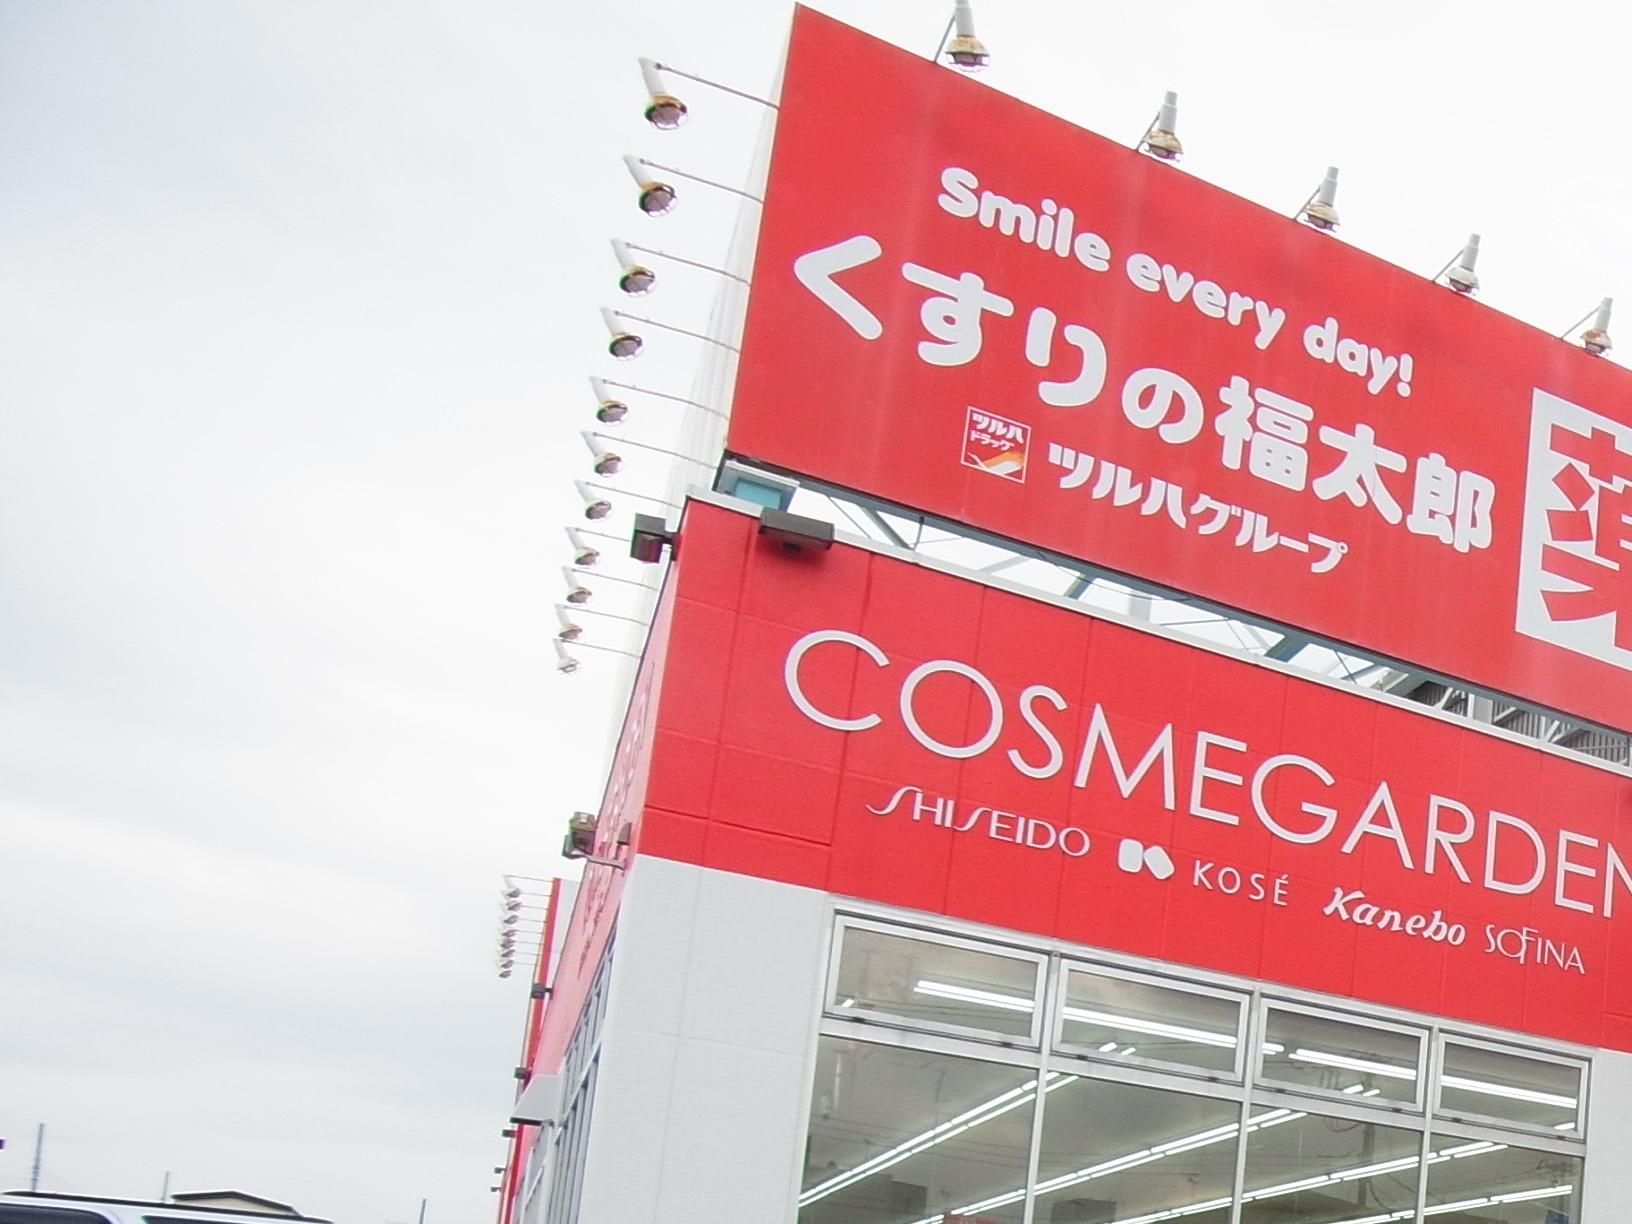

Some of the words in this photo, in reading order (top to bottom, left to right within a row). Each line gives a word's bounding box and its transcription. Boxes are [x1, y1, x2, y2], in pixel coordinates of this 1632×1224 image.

[938, 167, 1111, 272] Smile
[1126, 253, 1286, 350] every
[1303, 317, 1413, 398] day!
[794, 236, 1496, 553] くすりの福太郎
[970, 430, 1016, 451] ドラッグ
[972, 412, 1024, 444] ツルハ
[1049, 443, 1349, 574] ツルハグループ
[866, 786, 1090, 857] SHISEIDO
[1193, 860, 1289, 907] KOSÉ
[1323, 887, 1467, 946] Kanebo
[1484, 924, 1586, 974] SOFINA
